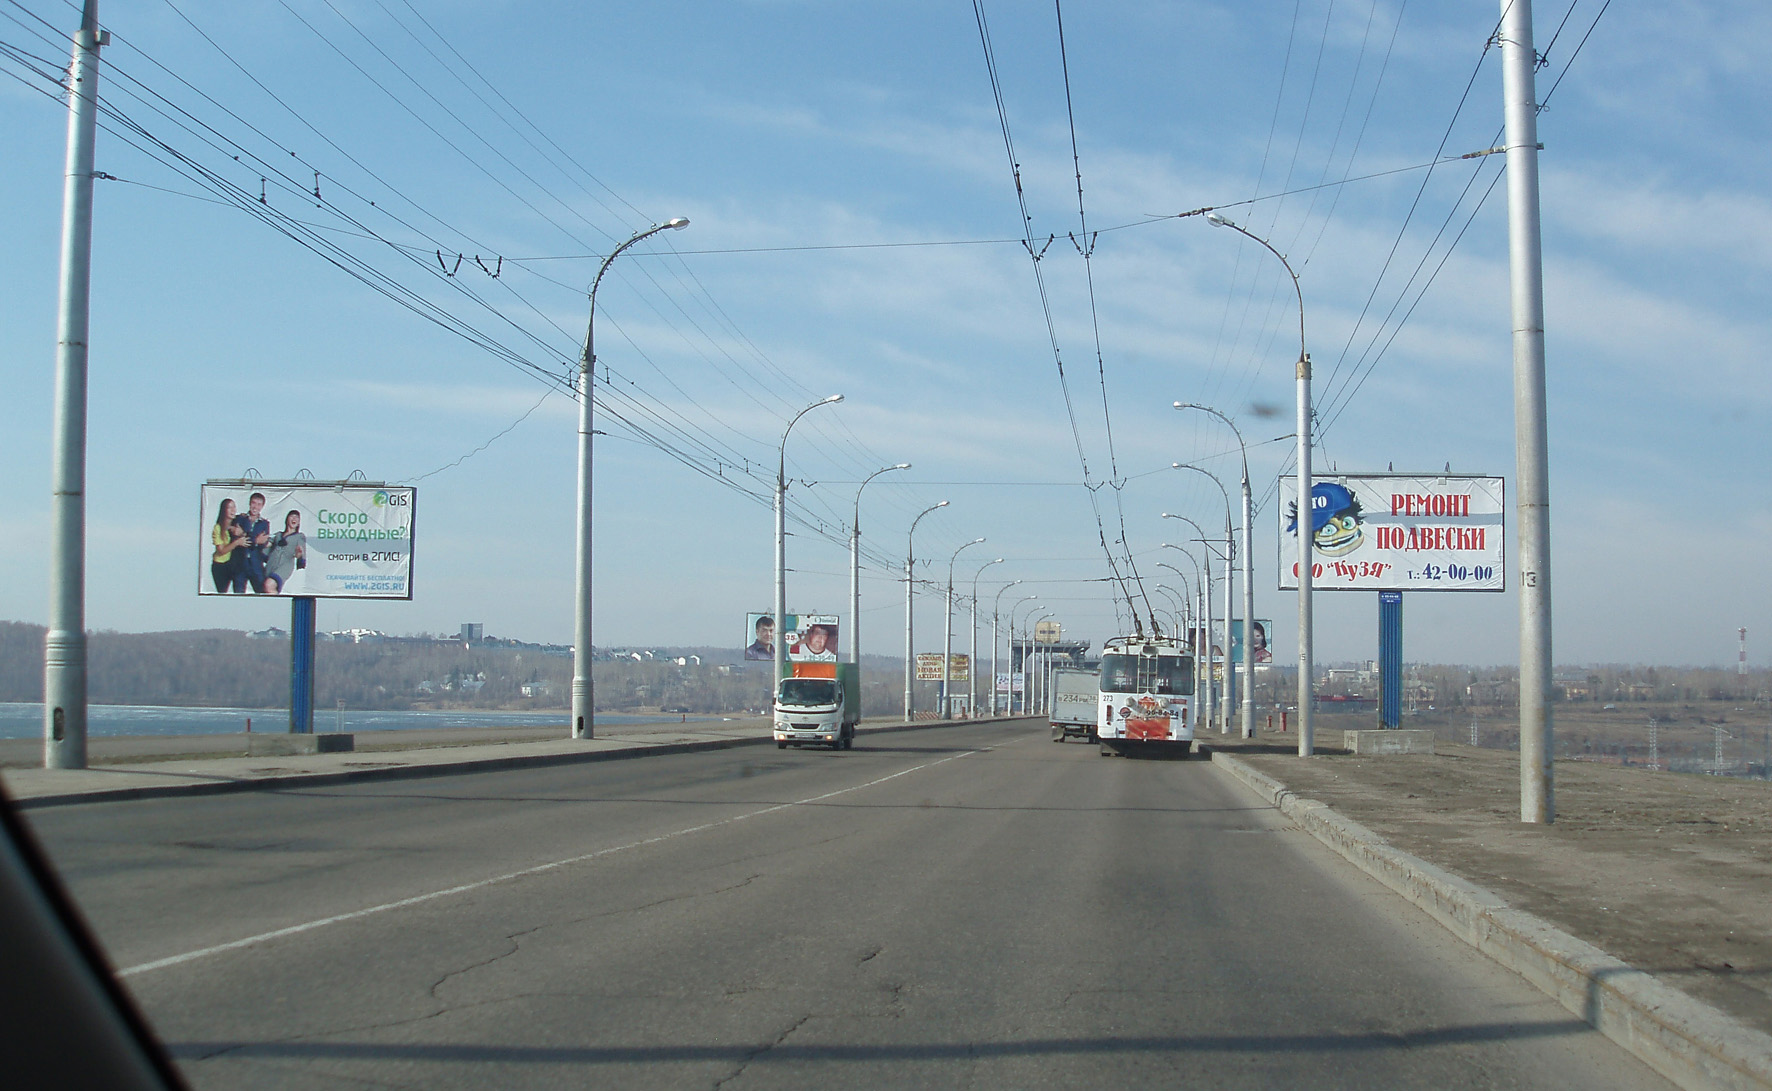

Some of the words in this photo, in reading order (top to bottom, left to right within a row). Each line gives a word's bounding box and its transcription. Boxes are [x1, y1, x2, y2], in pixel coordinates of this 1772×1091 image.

[1391, 493, 1471, 517] РЕМОНТ
[318, 509, 368, 528] Скоро
[317, 526, 406, 542] выходные?
[1376, 527, 1485, 553] ПОДВЕСКИ
[328, 553, 360, 563] смотри
[362, 553, 369, 561] в
[371, 552, 400, 562] 2ГИС!
[1422, 562, 1493, 581] 42-00-00
[344, 582, 405, 591] WWW.2GIS.RU
[1102, 694, 1114, 702] 273
